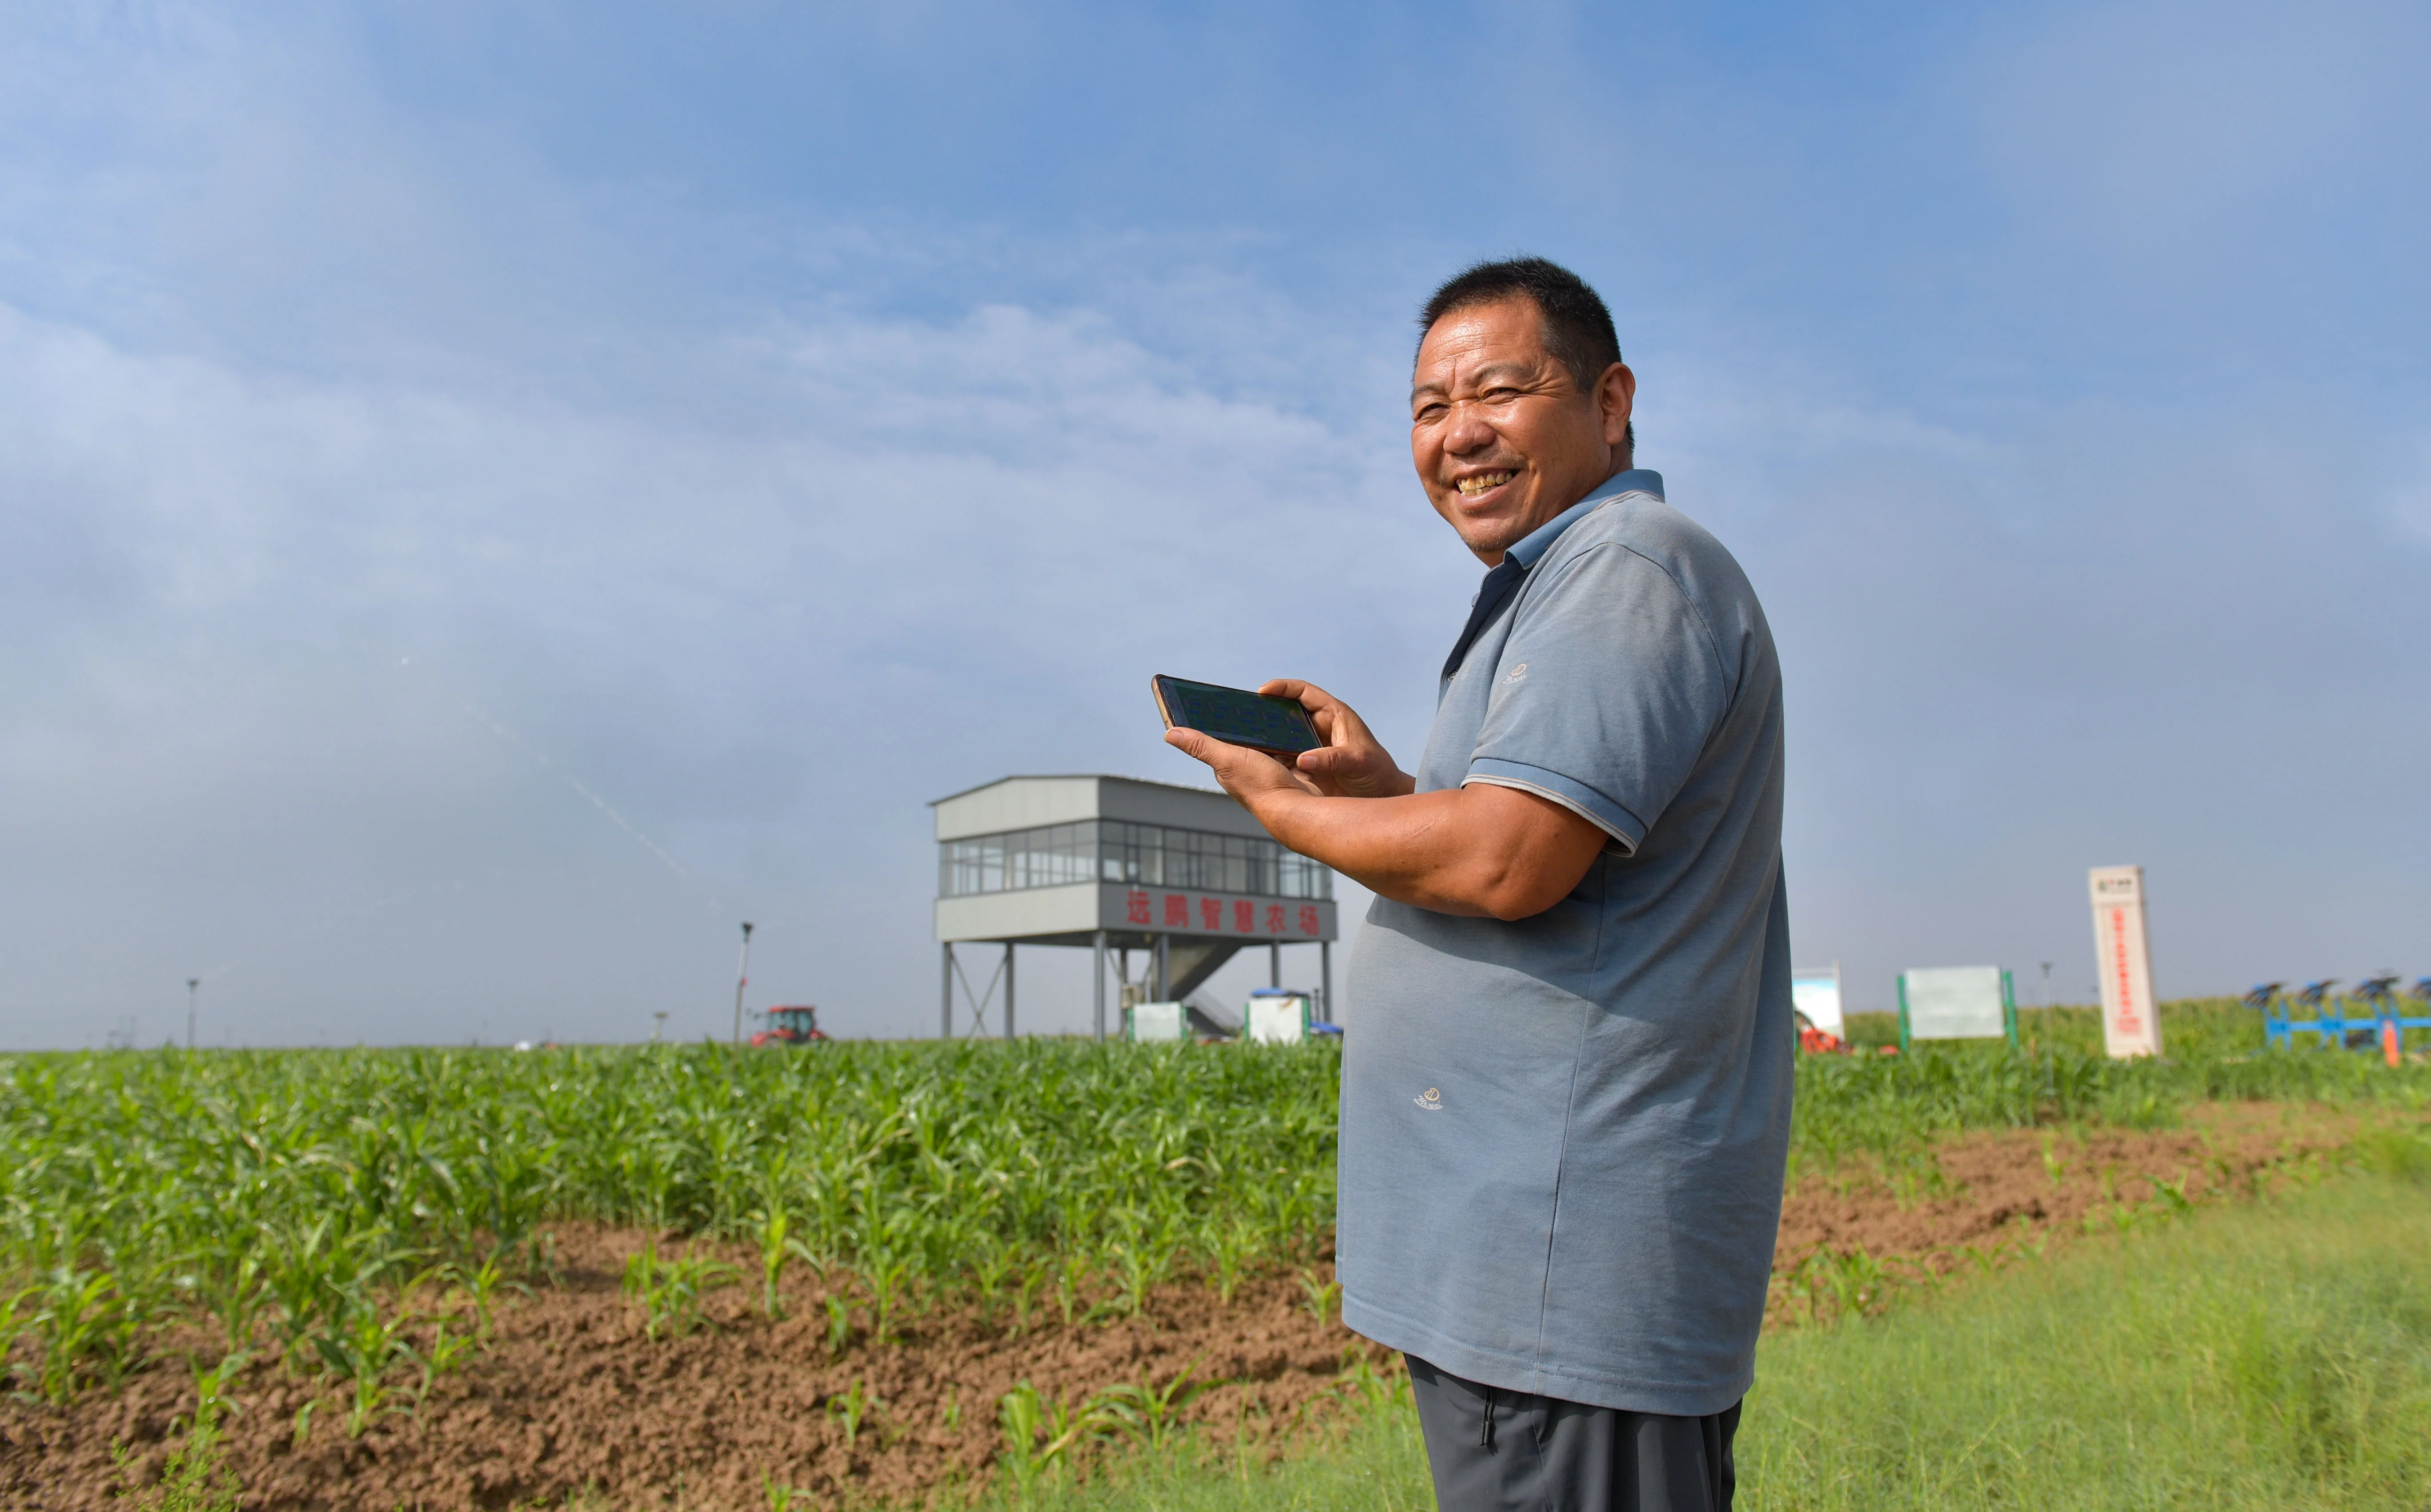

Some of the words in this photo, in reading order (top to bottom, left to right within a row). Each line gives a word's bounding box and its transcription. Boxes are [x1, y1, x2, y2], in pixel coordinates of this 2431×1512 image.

[1127, 890, 1319, 935] 远鹏智慧农场
